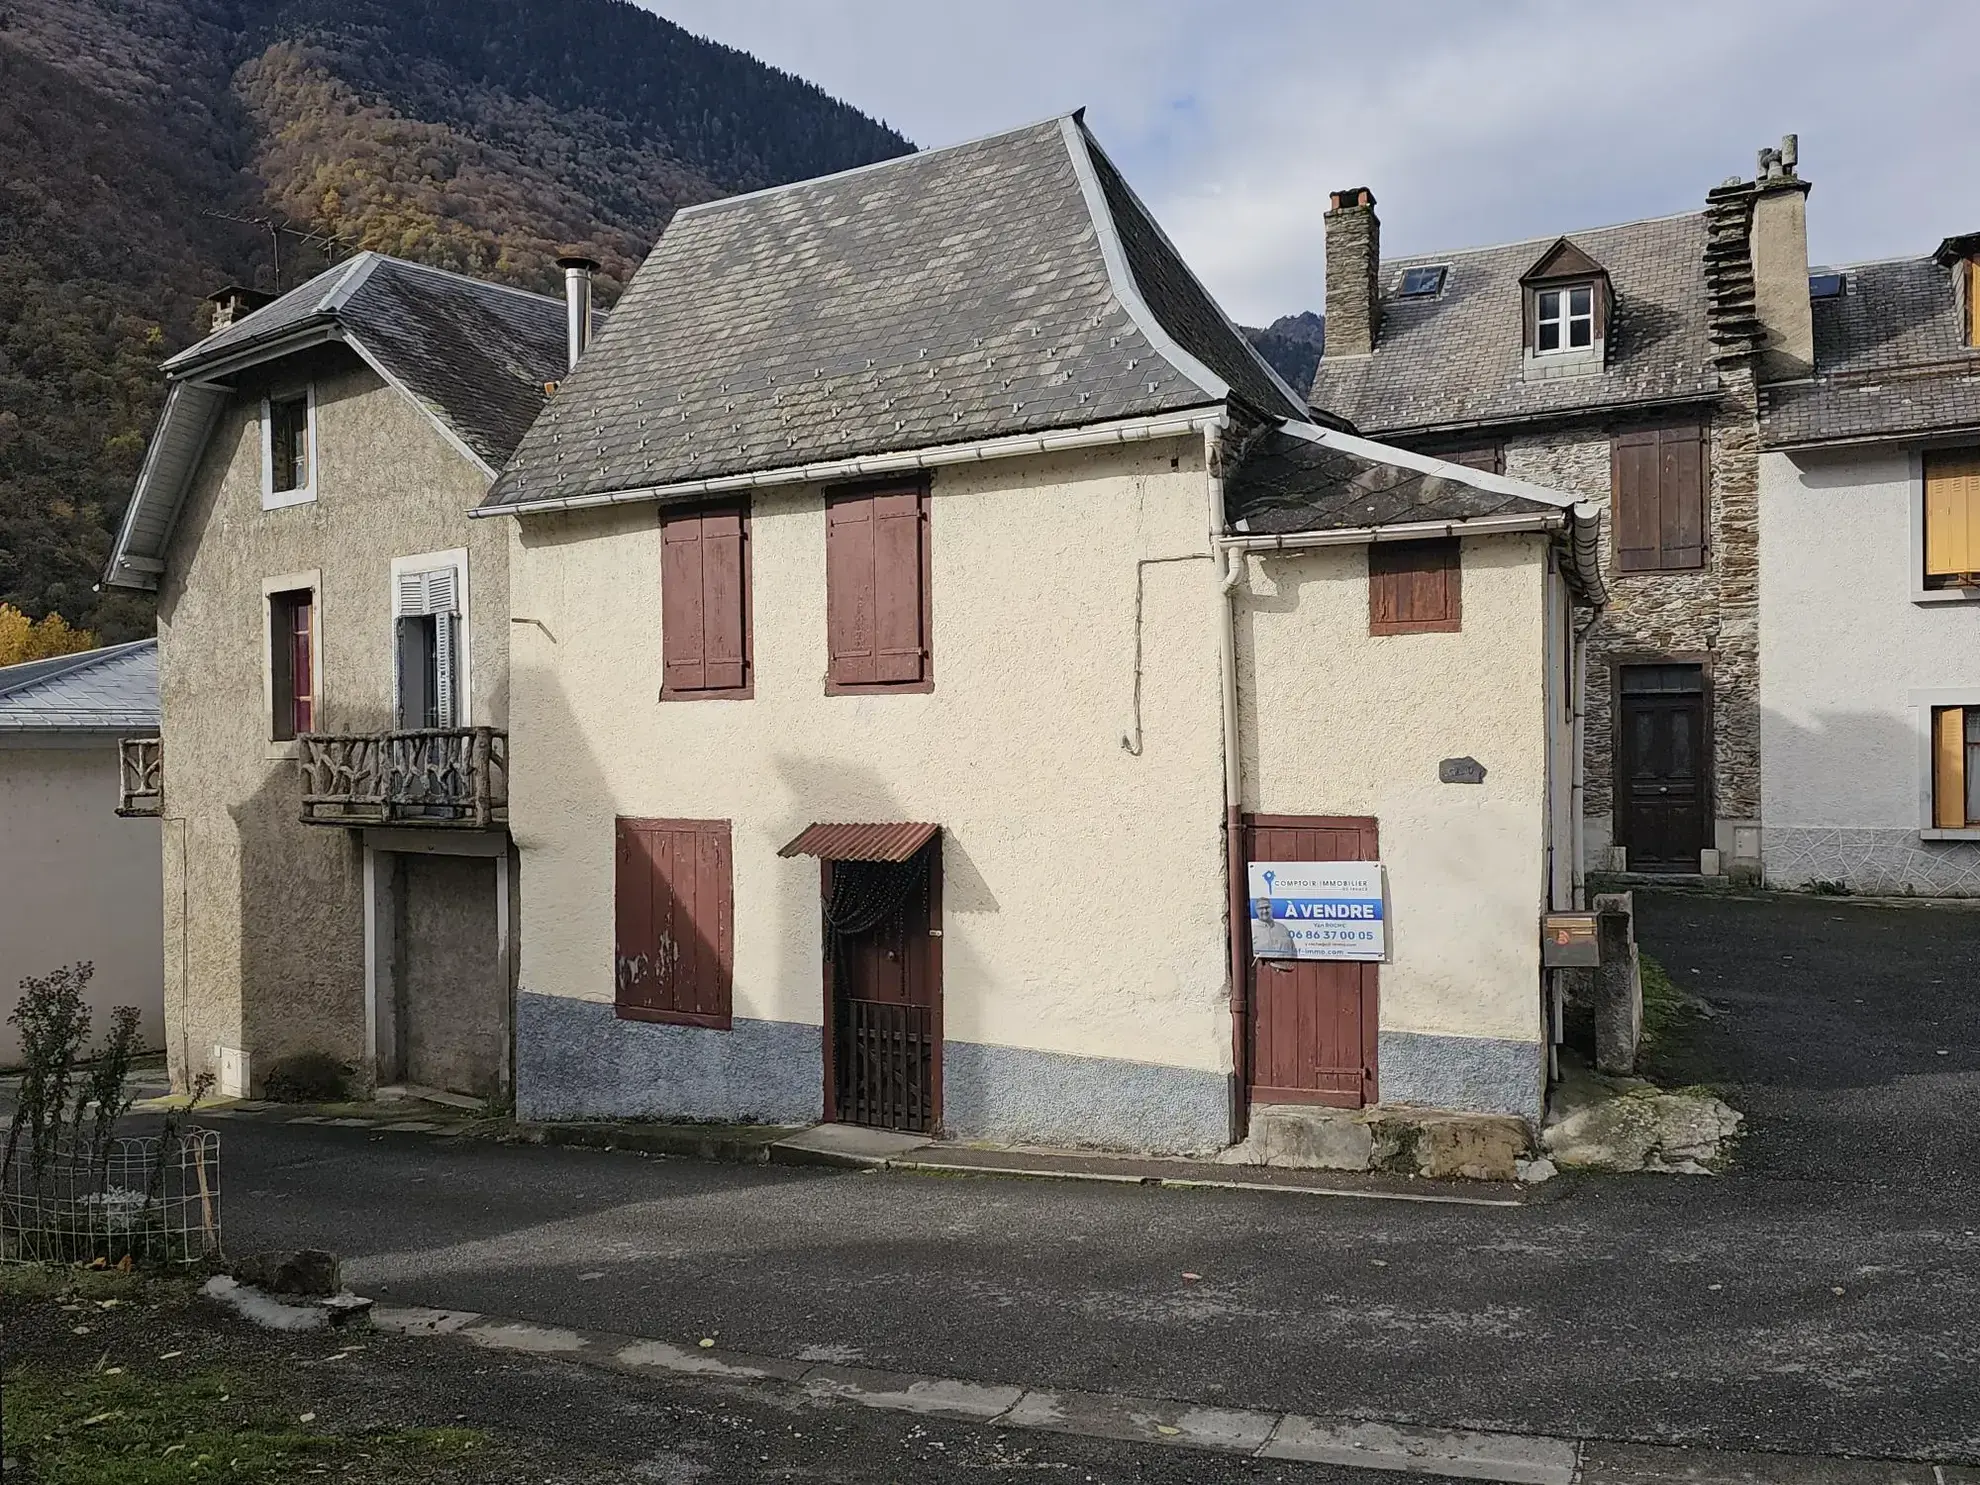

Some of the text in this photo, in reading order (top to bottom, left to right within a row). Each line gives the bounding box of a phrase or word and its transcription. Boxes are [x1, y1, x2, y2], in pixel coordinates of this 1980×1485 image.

[1285, 900, 1375, 919] À VENDRE
[1288, 930, 1374, 940] 06 86 37 00 05
